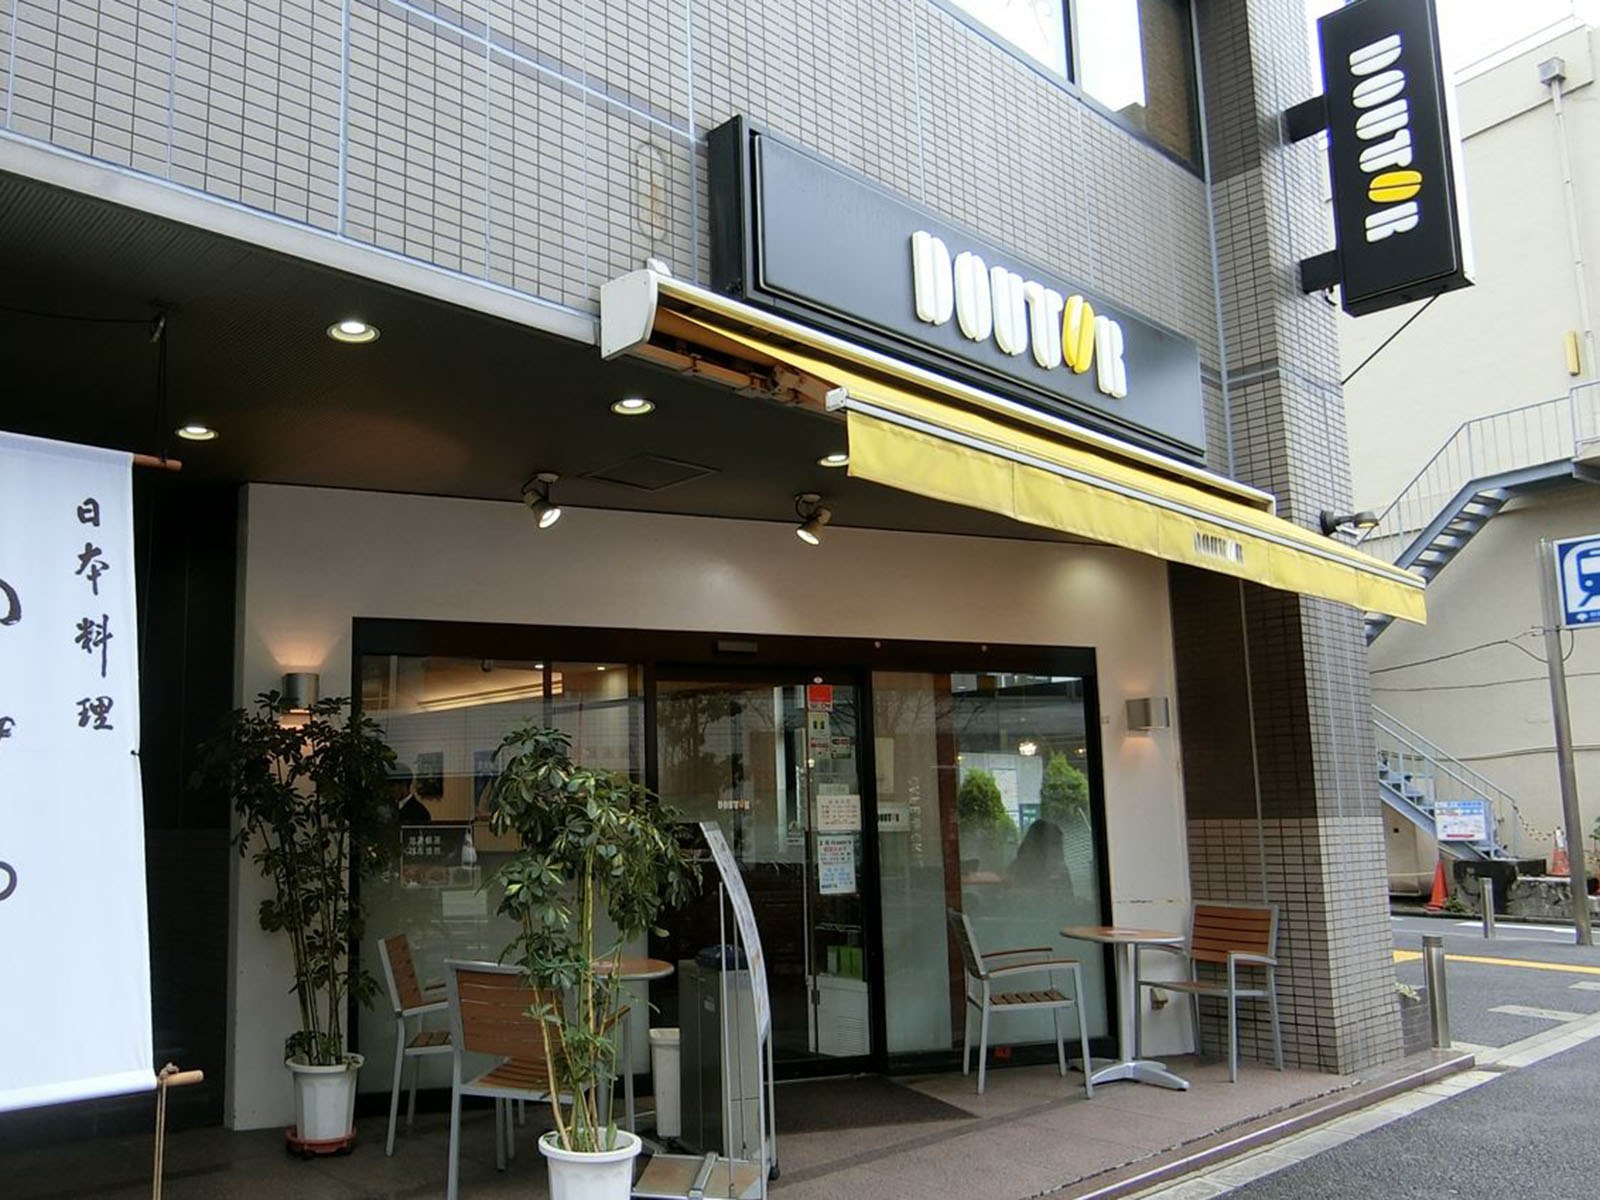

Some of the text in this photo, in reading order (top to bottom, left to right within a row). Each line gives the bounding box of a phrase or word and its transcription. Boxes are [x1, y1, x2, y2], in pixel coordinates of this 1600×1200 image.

[1349, 34, 1422, 243] DOUTOR
[912, 230, 1127, 399] DOUTOR
[75, 498, 114, 730] 日本料理
